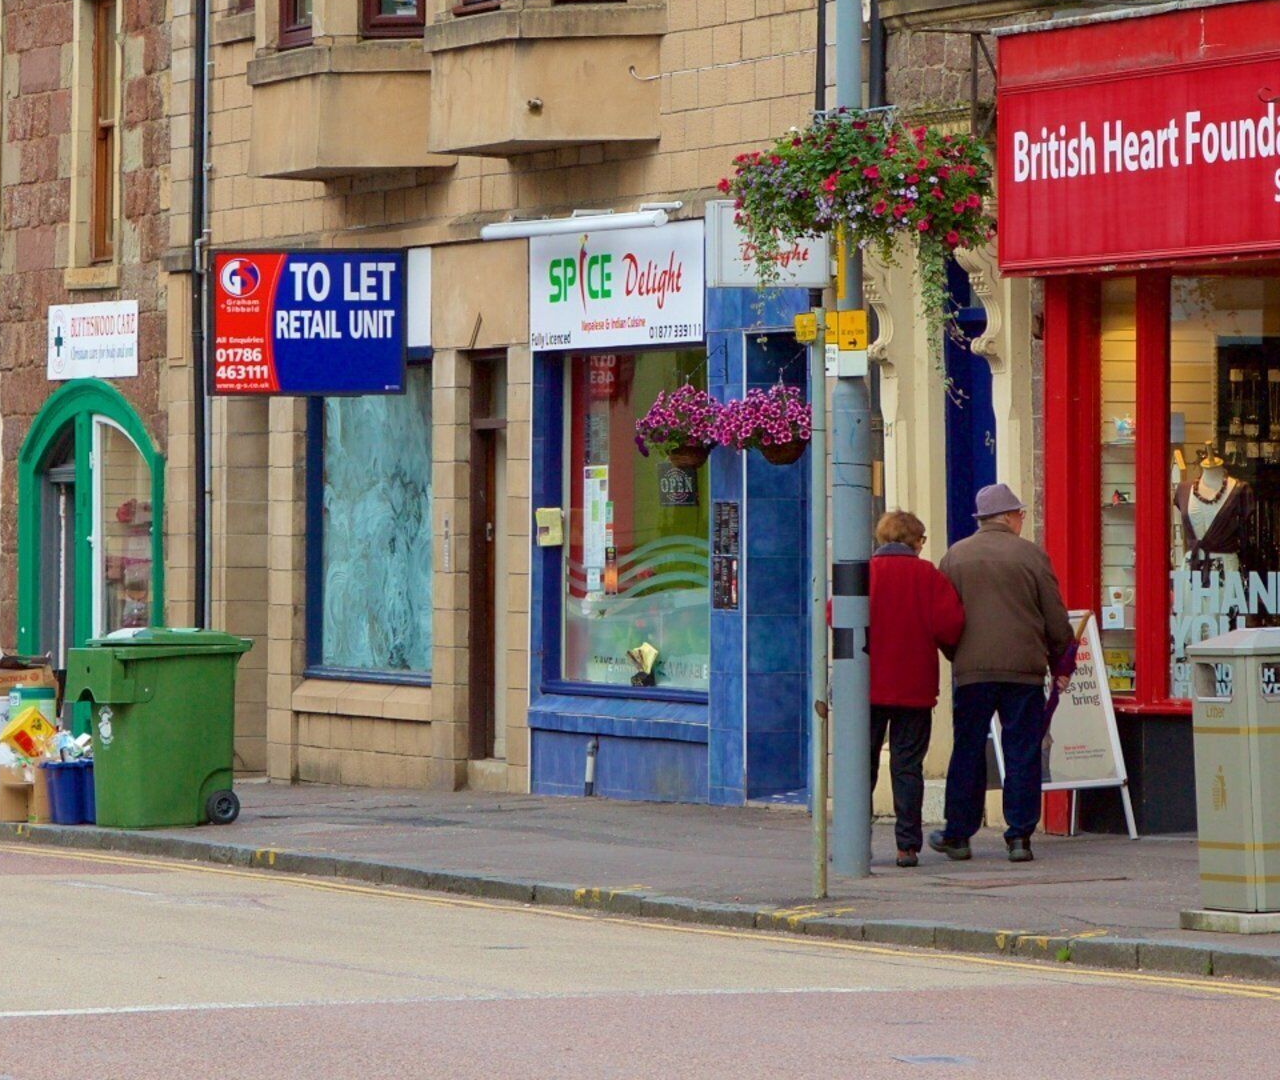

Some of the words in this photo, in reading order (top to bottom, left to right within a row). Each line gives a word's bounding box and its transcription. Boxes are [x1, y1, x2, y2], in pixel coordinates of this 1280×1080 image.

[1014, 121, 1096, 183] British
[1103, 119, 1179, 173] Heart
[289, 262, 331, 302] TO
[343, 262, 396, 301] LET
[549, 242, 612, 313] SPICE
[622, 250, 683, 310] Delight
[71, 315, 115, 337] BLYTHSWOOD
[116, 313, 136, 334] CARE
[276, 310, 342, 339] RETAIL
[348, 309, 395, 339] UNIT
[649, 326, 672, 339] 01877
[674, 323, 702, 337] 339111
[229, 336, 264, 345] Enquiries
[531, 332, 545, 349] Fully
[545, 331, 571, 345] Licenced
[216, 348, 262, 362] 01786
[216, 365, 269, 379] 463111
[984, 430, 996, 455] 27
[661, 476, 693, 492] OPEN
[1077, 680, 1097, 693] you
[1072, 694, 1100, 706] bring
